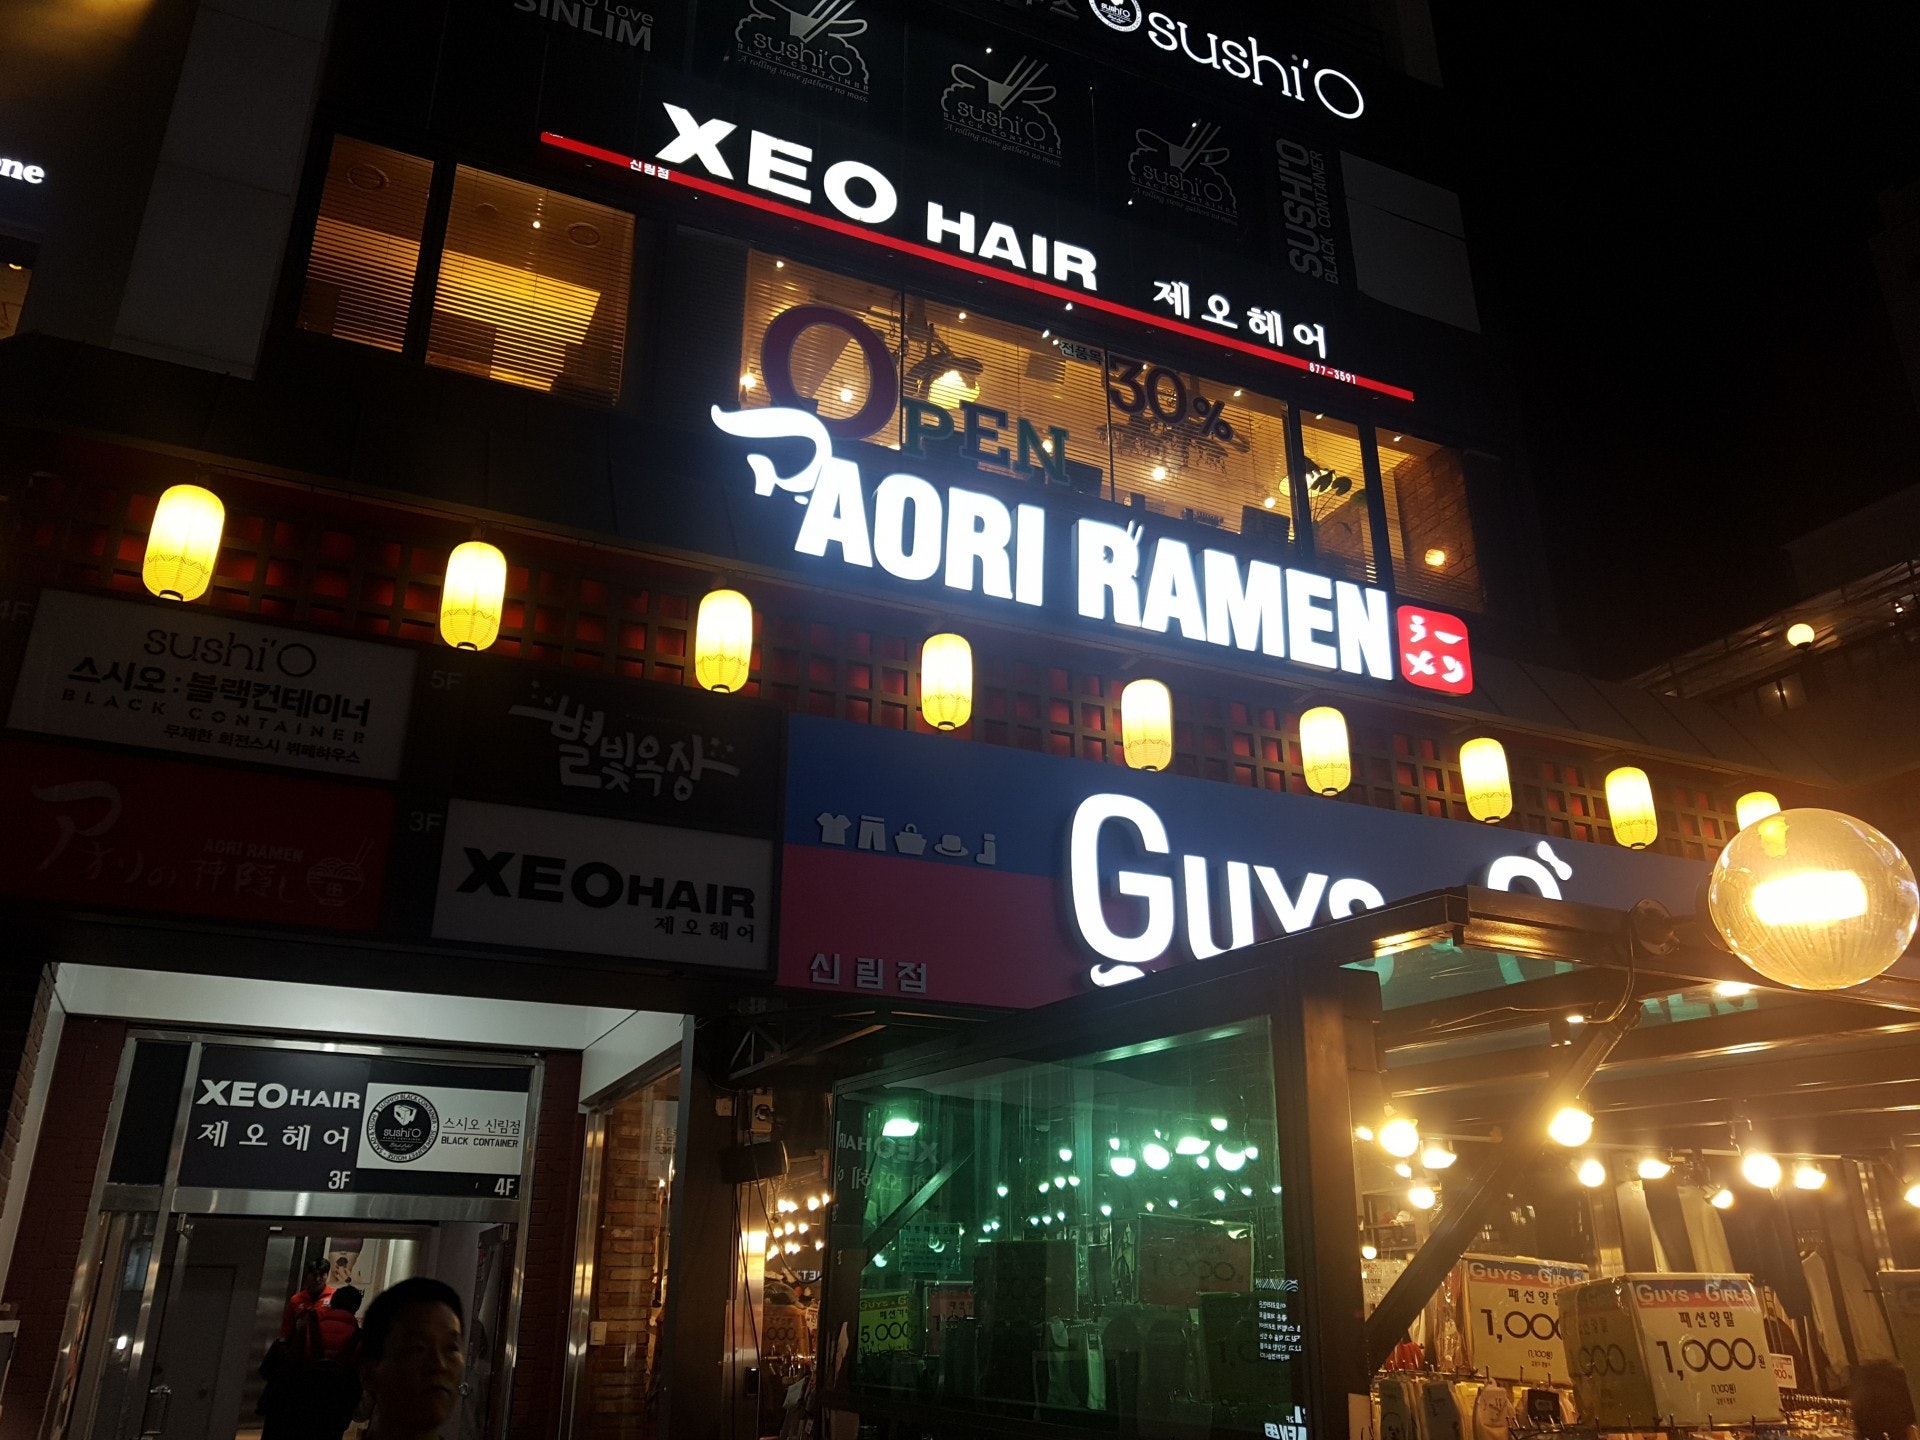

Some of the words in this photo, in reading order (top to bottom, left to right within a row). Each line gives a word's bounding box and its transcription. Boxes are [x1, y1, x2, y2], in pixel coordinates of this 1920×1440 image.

[0, 158, 45, 184] ne
[654, 102, 898, 224] XEO
[927, 201, 1098, 291] HAIR
[1309, 362, 1356, 385] 877-3591
[1078, 518, 1393, 681] RAMEN
[431, 669, 463, 691] 5F
[62, 688, 166, 716] BLACK
[188, 706, 366, 744] CONTAINER
[408, 810, 444, 833] 3F
[442, 1116, 480, 1131] 스시오
[485, 1118, 521, 1135] 신림점
[441, 1135, 469, 1146] BLACK
[473, 1137, 519, 1148] CONTAINER
[327, 1169, 351, 1190] 3F
[494, 1177, 516, 1197] 4F
